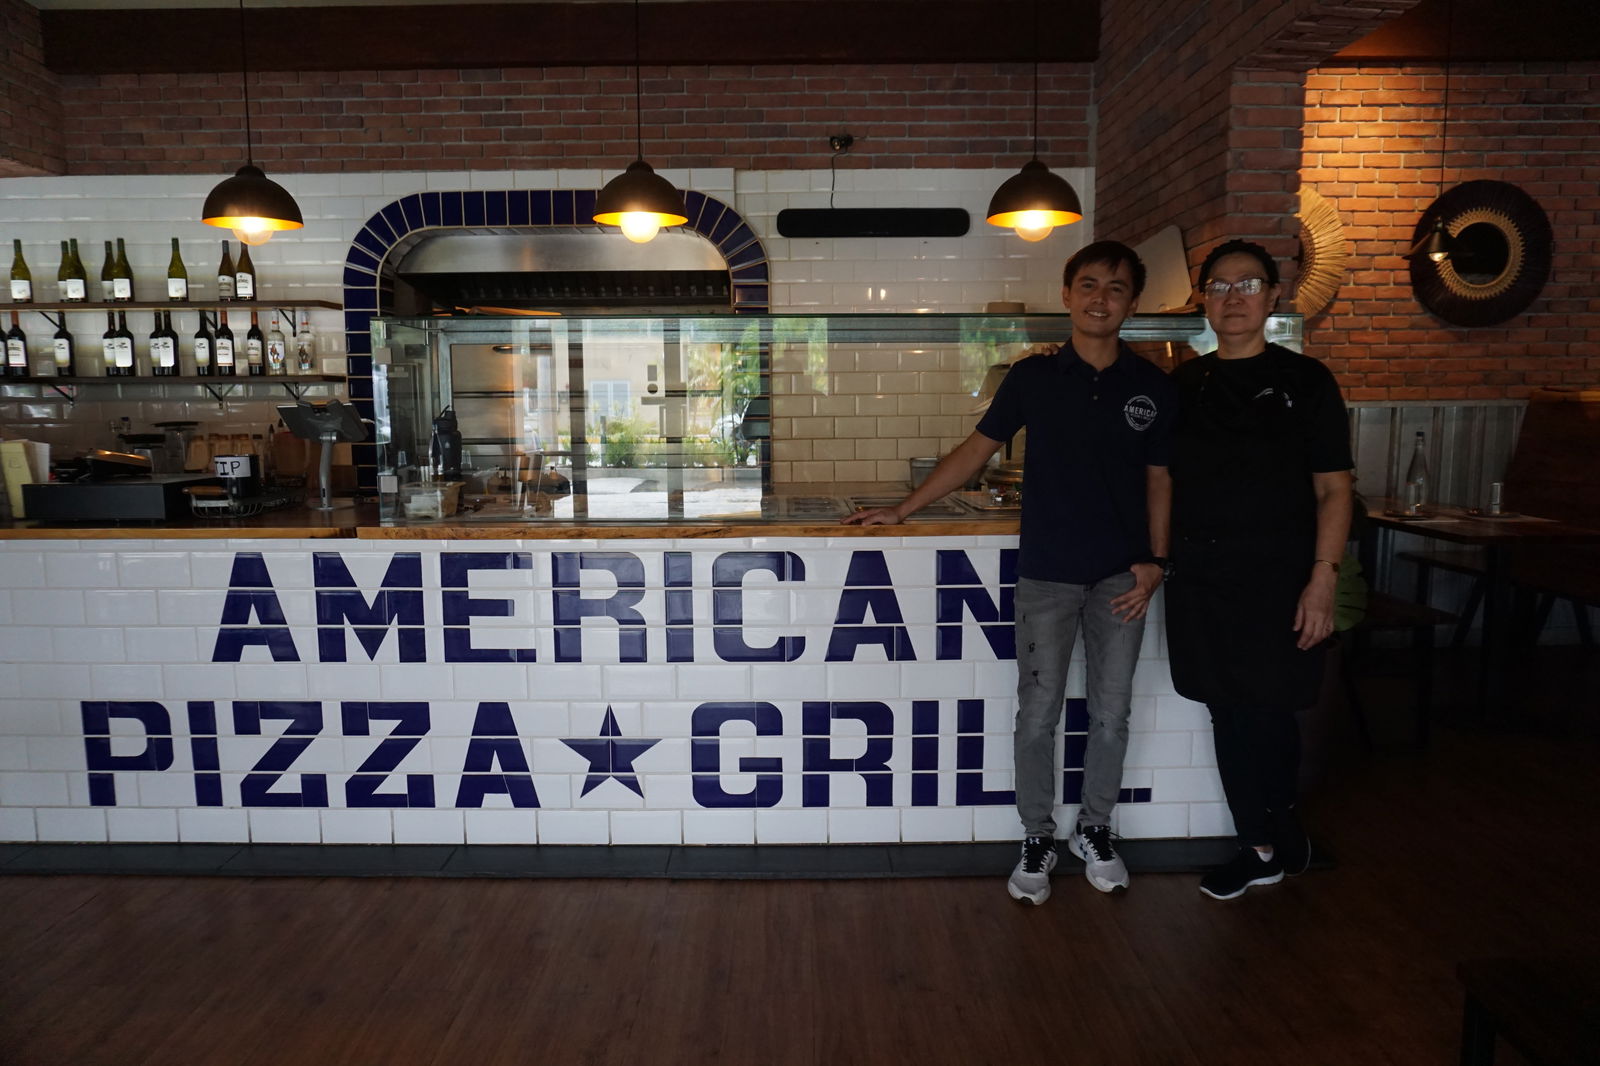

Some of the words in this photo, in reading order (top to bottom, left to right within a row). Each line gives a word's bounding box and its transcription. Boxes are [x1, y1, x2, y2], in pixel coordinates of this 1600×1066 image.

[212, 549, 1018, 662] AMERICAN
[81, 700, 541, 808] PIZZA
[691, 698, 1152, 808] GRILL
